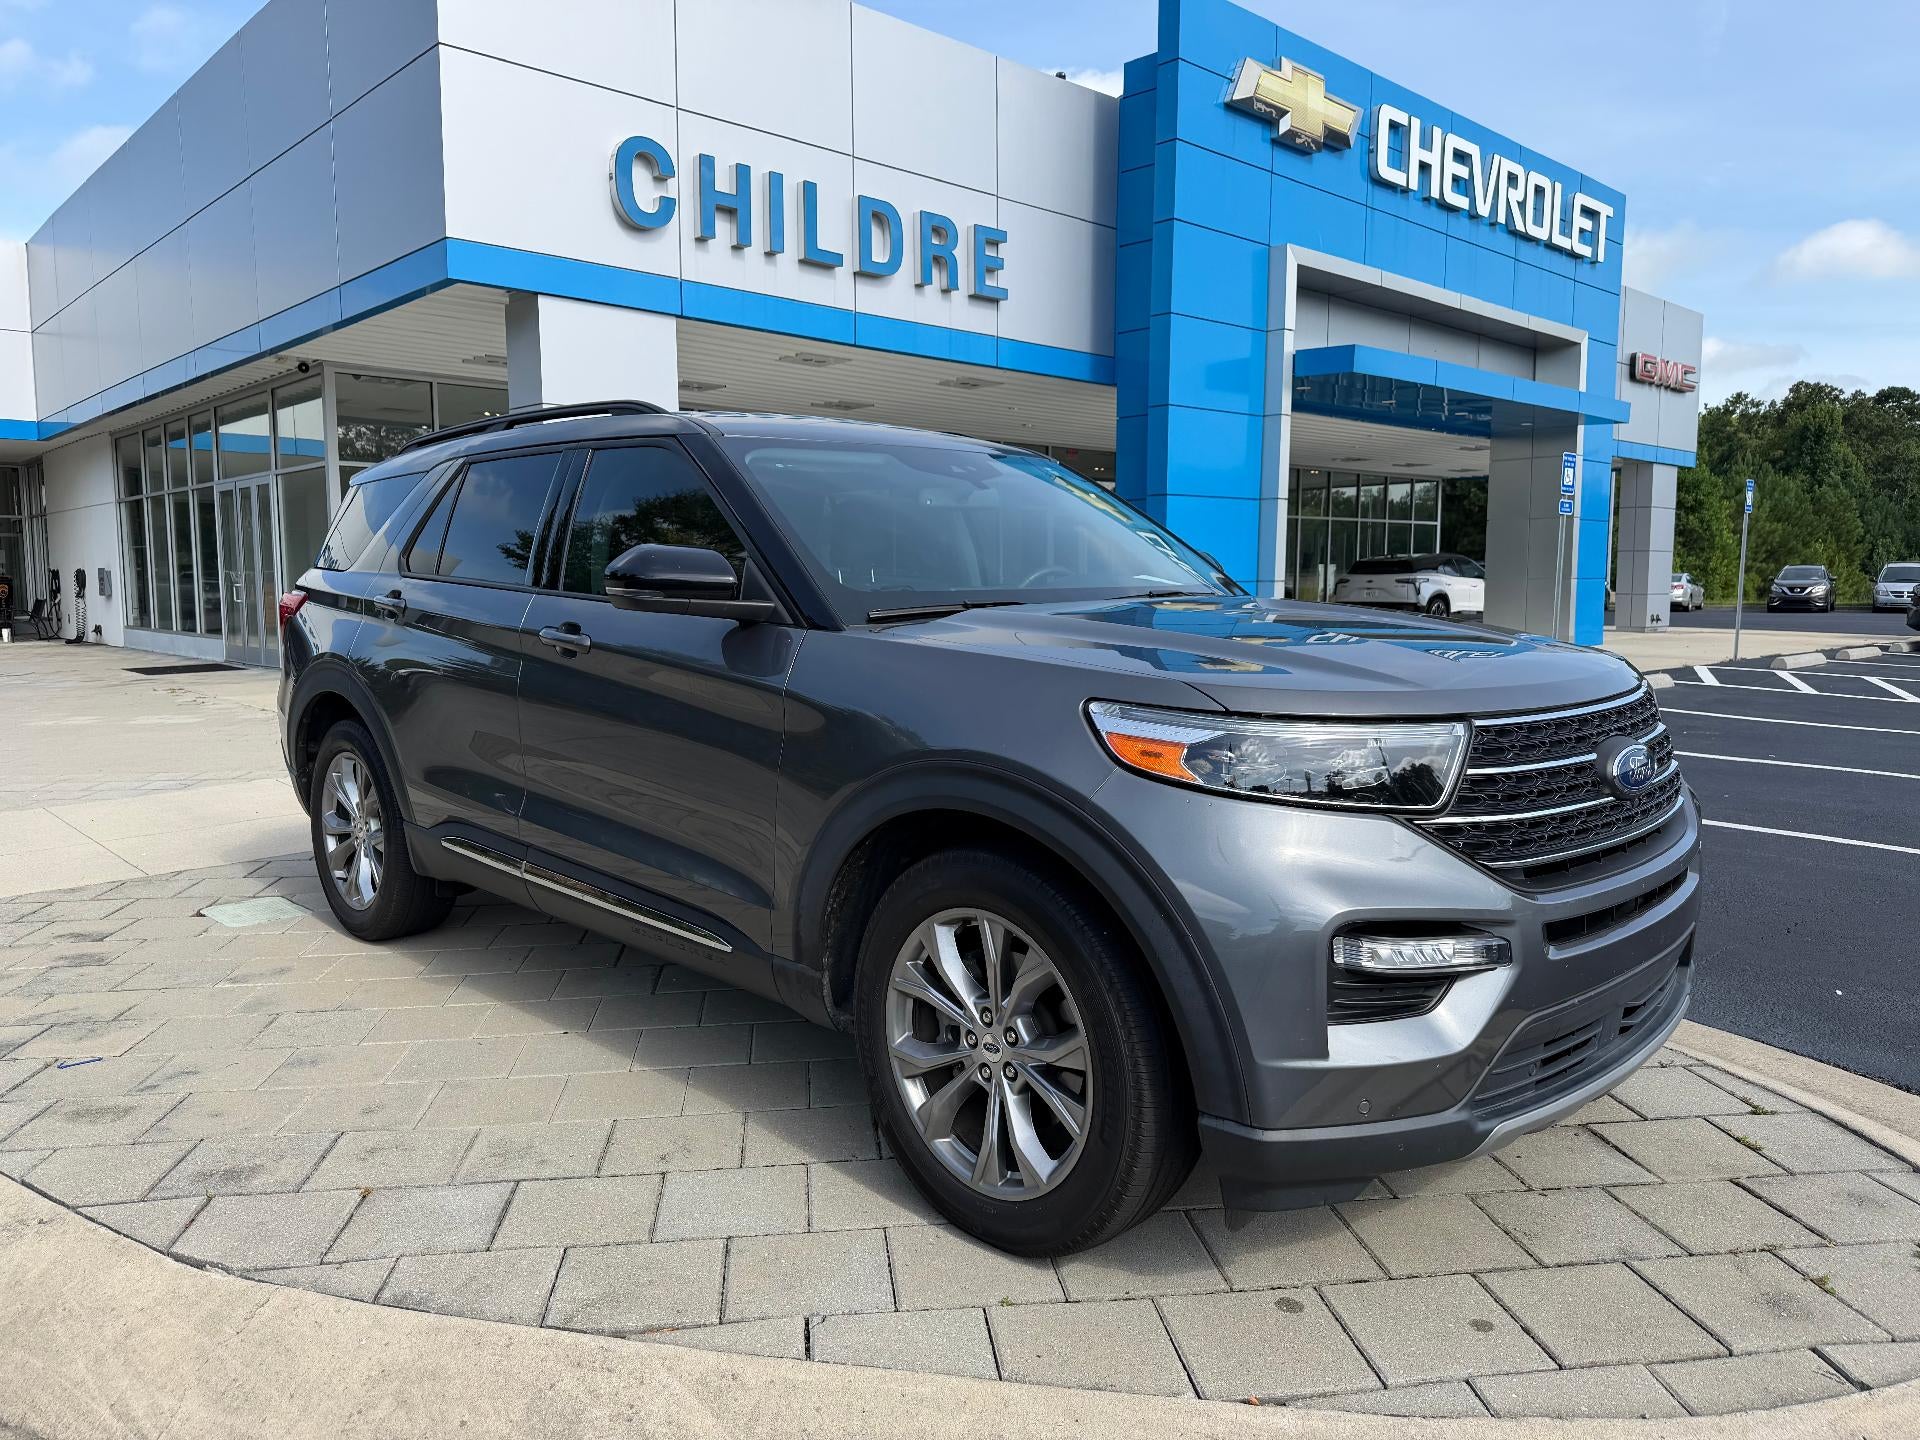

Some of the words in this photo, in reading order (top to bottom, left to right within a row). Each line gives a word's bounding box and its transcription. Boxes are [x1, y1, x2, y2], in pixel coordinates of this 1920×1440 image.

[609, 135, 1009, 302] CHILDRE
[1370, 103, 1614, 264] CHEVROLET
[1631, 352, 1697, 393] GMC
